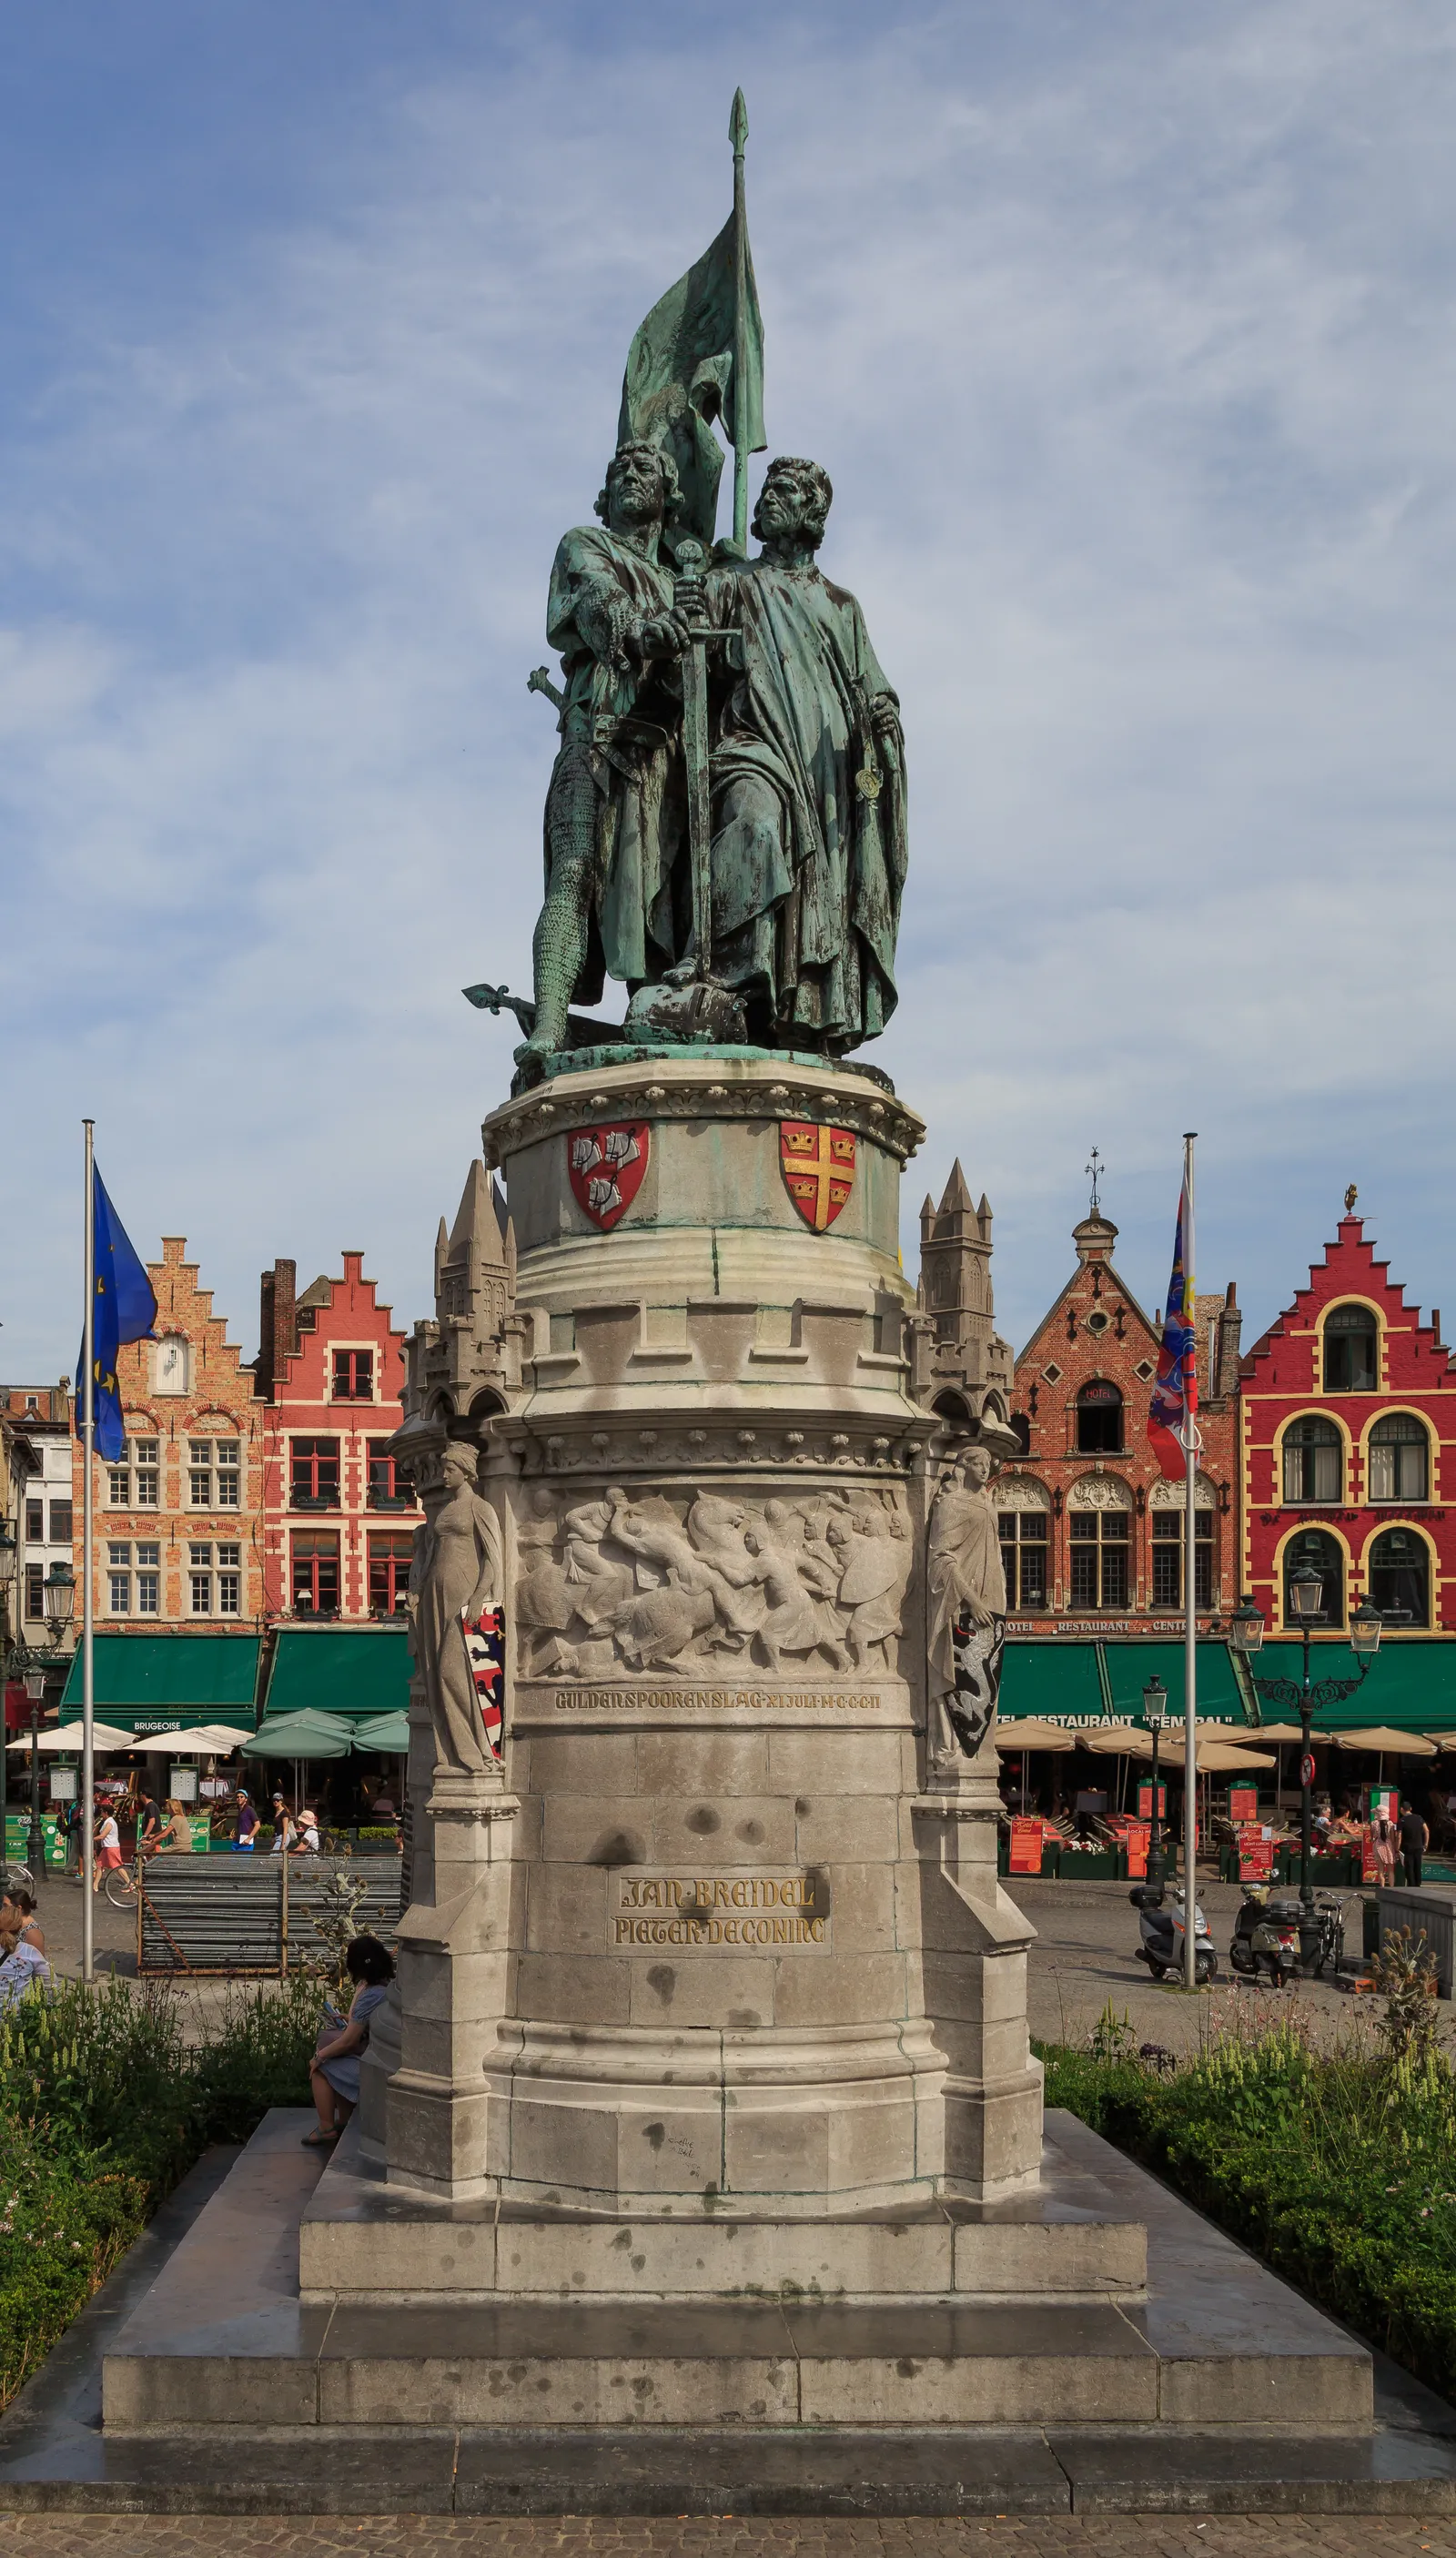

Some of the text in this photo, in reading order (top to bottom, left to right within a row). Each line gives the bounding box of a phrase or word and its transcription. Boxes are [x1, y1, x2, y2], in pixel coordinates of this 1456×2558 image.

[1086, 1388, 1111, 1399] HOTEL
[1005, 1621, 1203, 1632] OTEL RESTAURANT CENTRL
[556, 1691, 763, 1709] GULDENSPOORENSLAG
[134, 1722, 181, 1730] BRUGEOISE
[693, 1878, 814, 1908] BREIDEL
